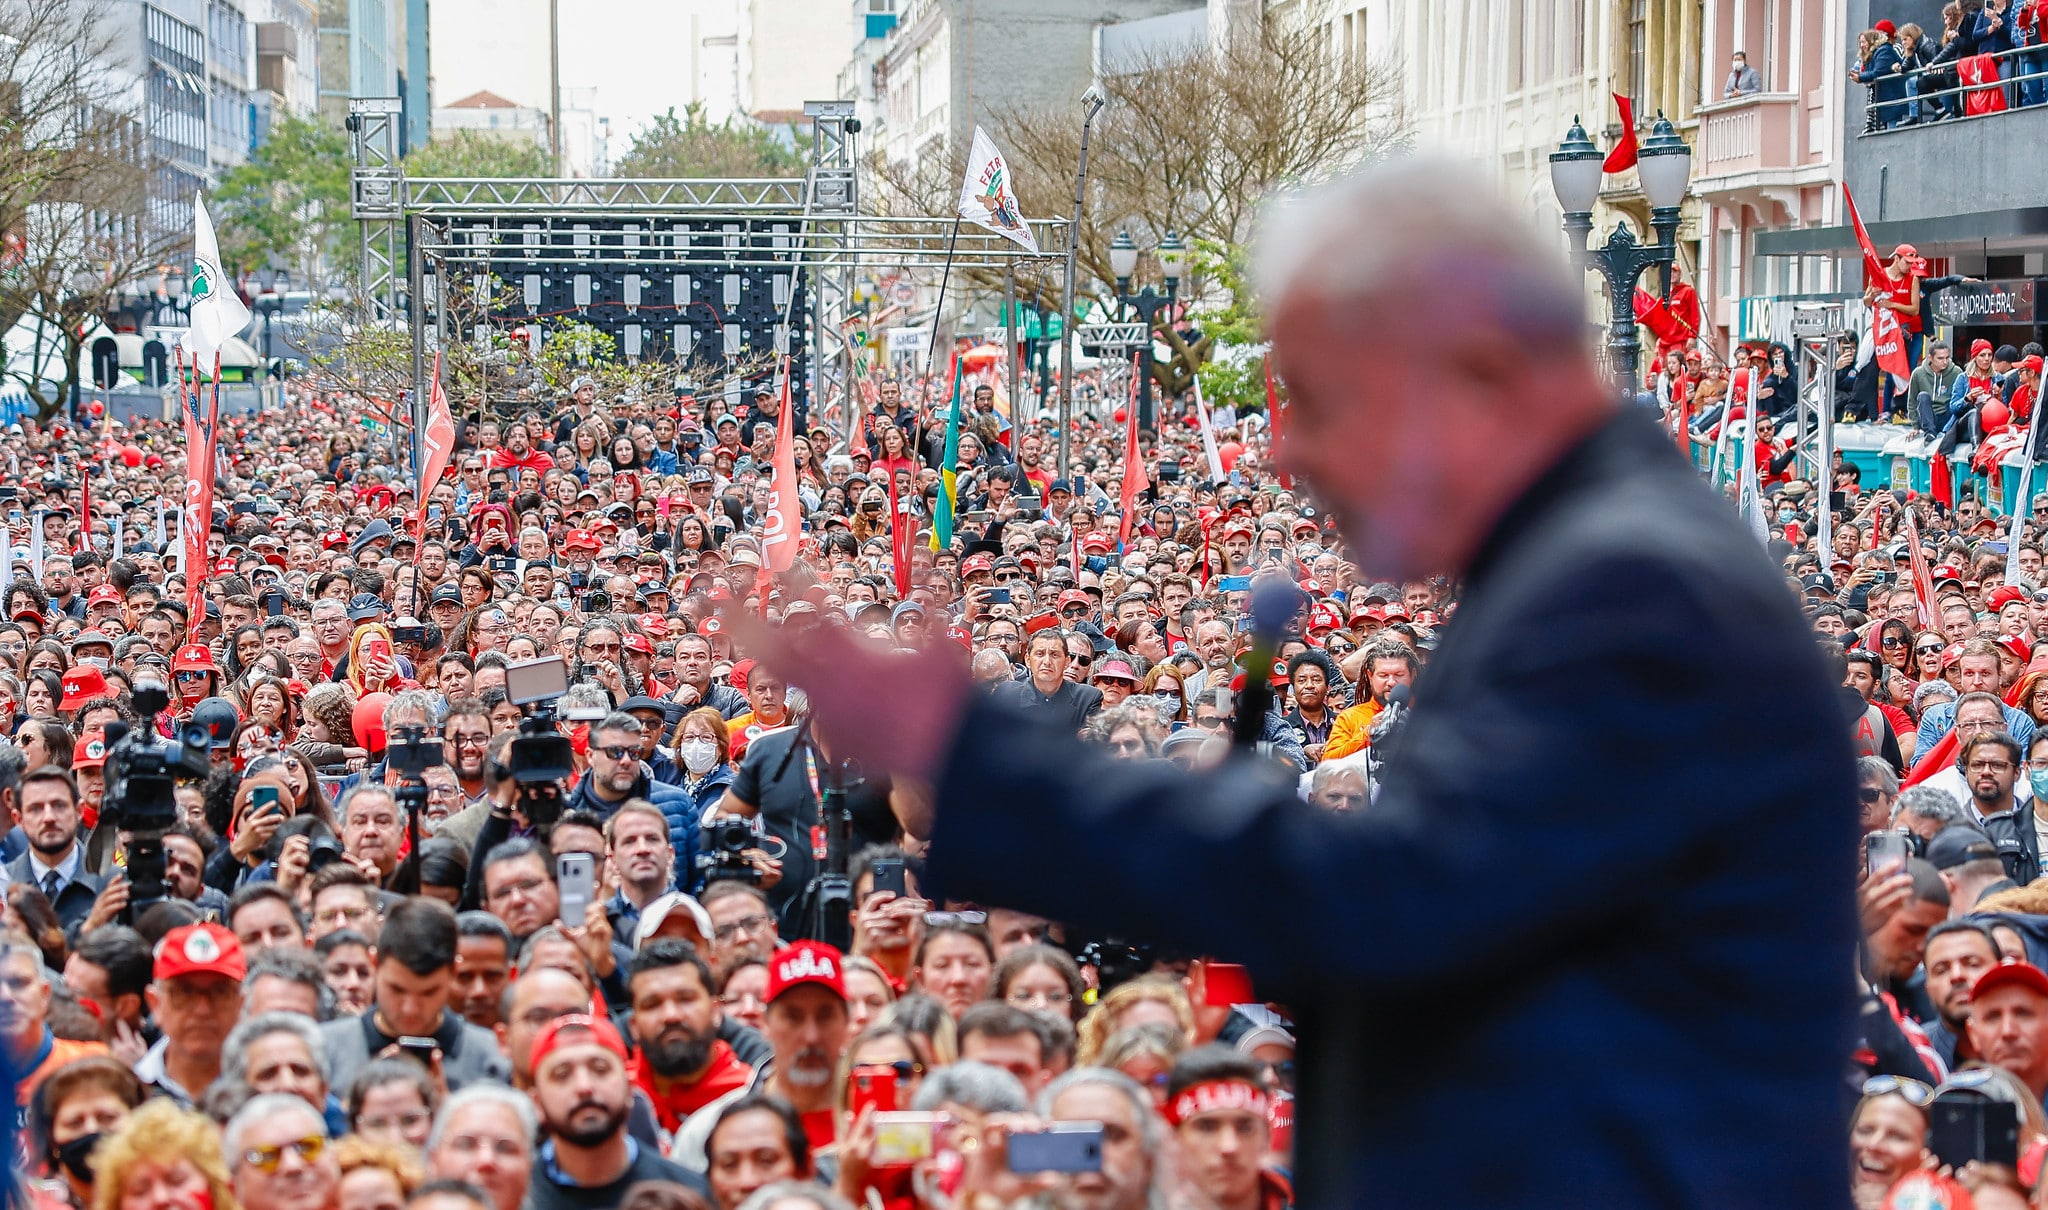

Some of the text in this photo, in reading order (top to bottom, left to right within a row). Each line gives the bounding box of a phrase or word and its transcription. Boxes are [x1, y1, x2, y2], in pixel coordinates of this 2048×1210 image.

[1939, 292, 2016, 315] REDE ANDRADE BRAZ
[1875, 342, 1898, 356] CHÃO
[946, 628, 965, 639] ULA
[185, 652, 201, 660] LULA
[64, 684, 80, 693] LULA
[780, 948, 836, 981] LULA
